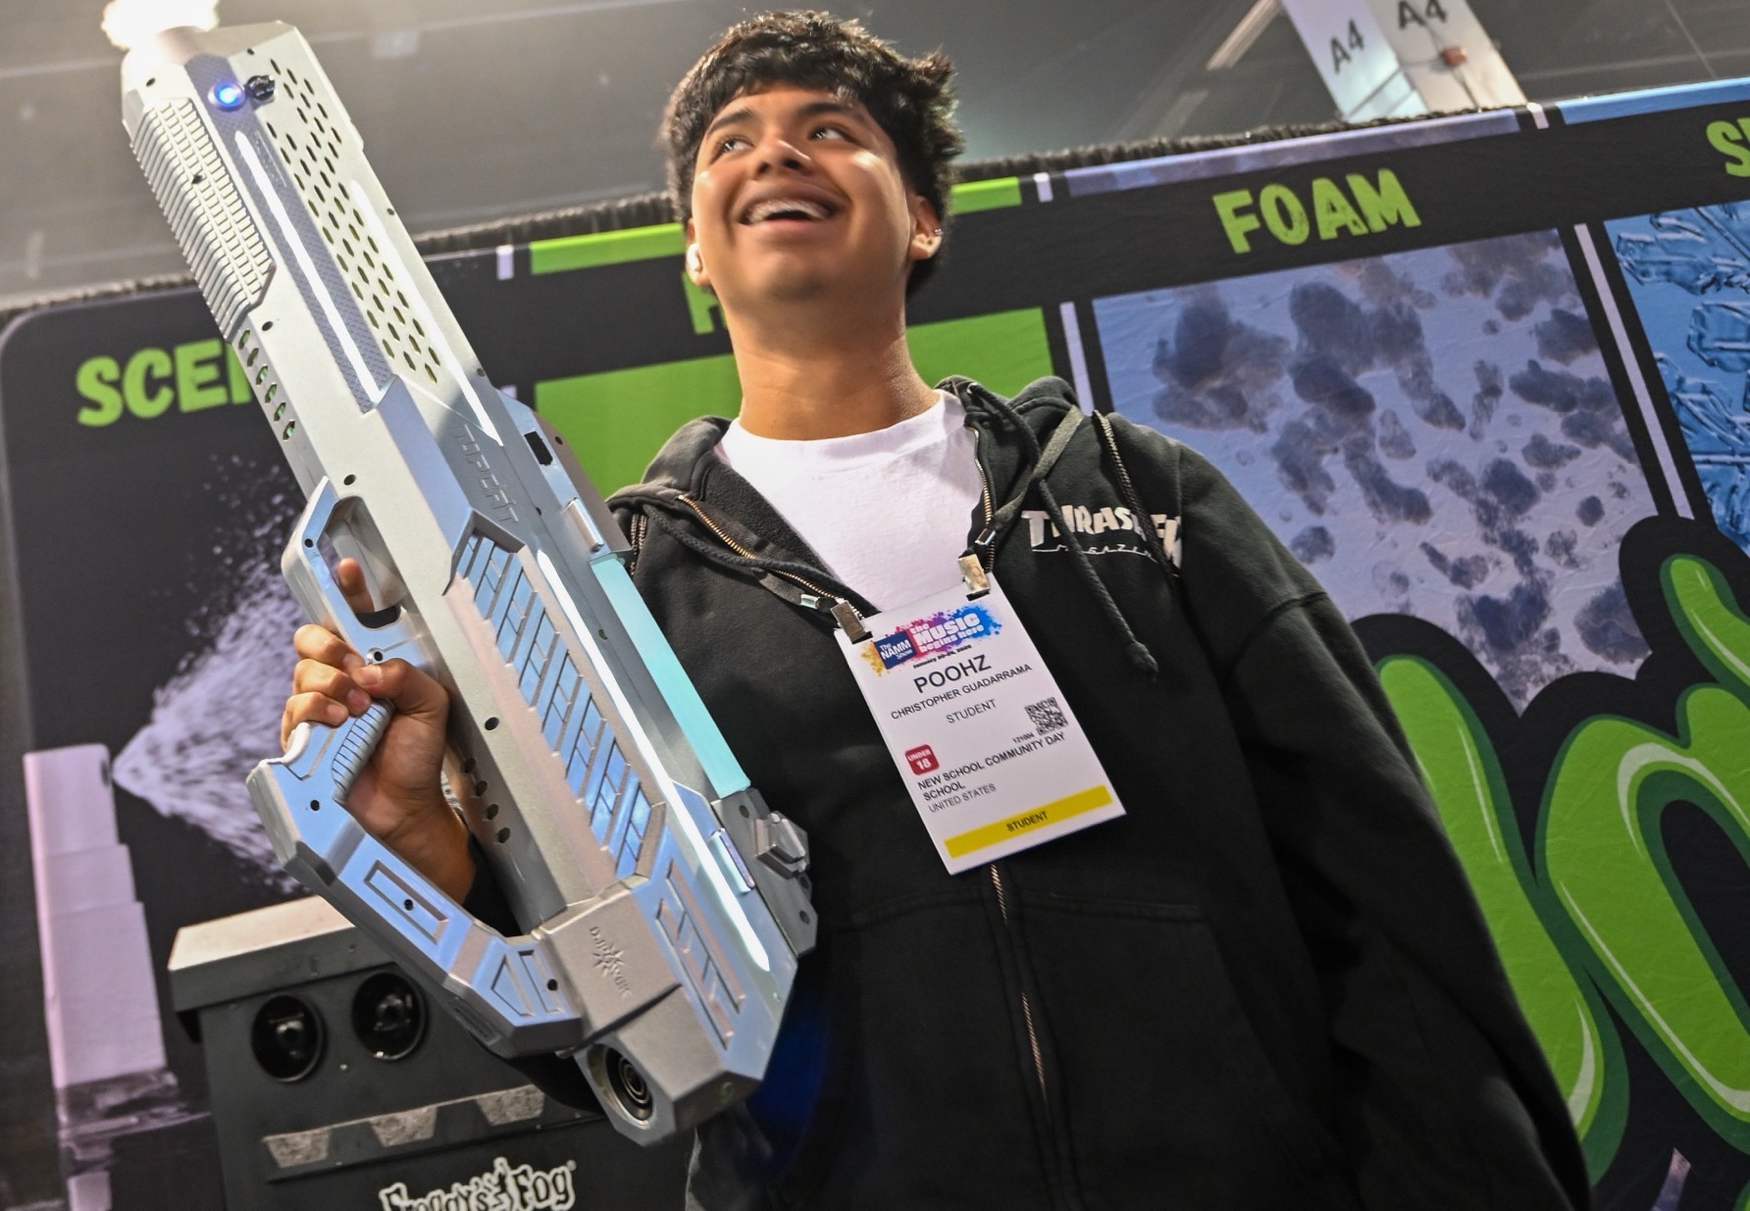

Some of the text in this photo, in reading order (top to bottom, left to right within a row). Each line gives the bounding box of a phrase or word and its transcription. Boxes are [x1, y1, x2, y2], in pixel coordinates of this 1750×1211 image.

[1330, 18, 1365, 75] A4
[1213, 167, 1422, 254] FOAM
[910, 623, 930, 634] the
[913, 612, 981, 646] MUSIC
[919, 624, 984, 653] begins here
[880, 642, 892, 650] The
[880, 639, 912, 660] NAMM
[896, 649, 913, 660] Show
[913, 654, 992, 694] POOHZ
[891, 664, 1033, 720] CHRISTOPHER GUADARRAMA
[946, 699, 998, 724] STUDENT
[907, 748, 932, 762] UNDER
[916, 760, 932, 771] 18
[917, 732, 1067, 790] NEW SCHOOL COMMUNITY DAY
[923, 781, 966, 801] SCHOOL
[928, 783, 997, 813] UNITED STATES
[1006, 810, 1048, 832] STUDENT
[511, 1164, 575, 1211] Fog
